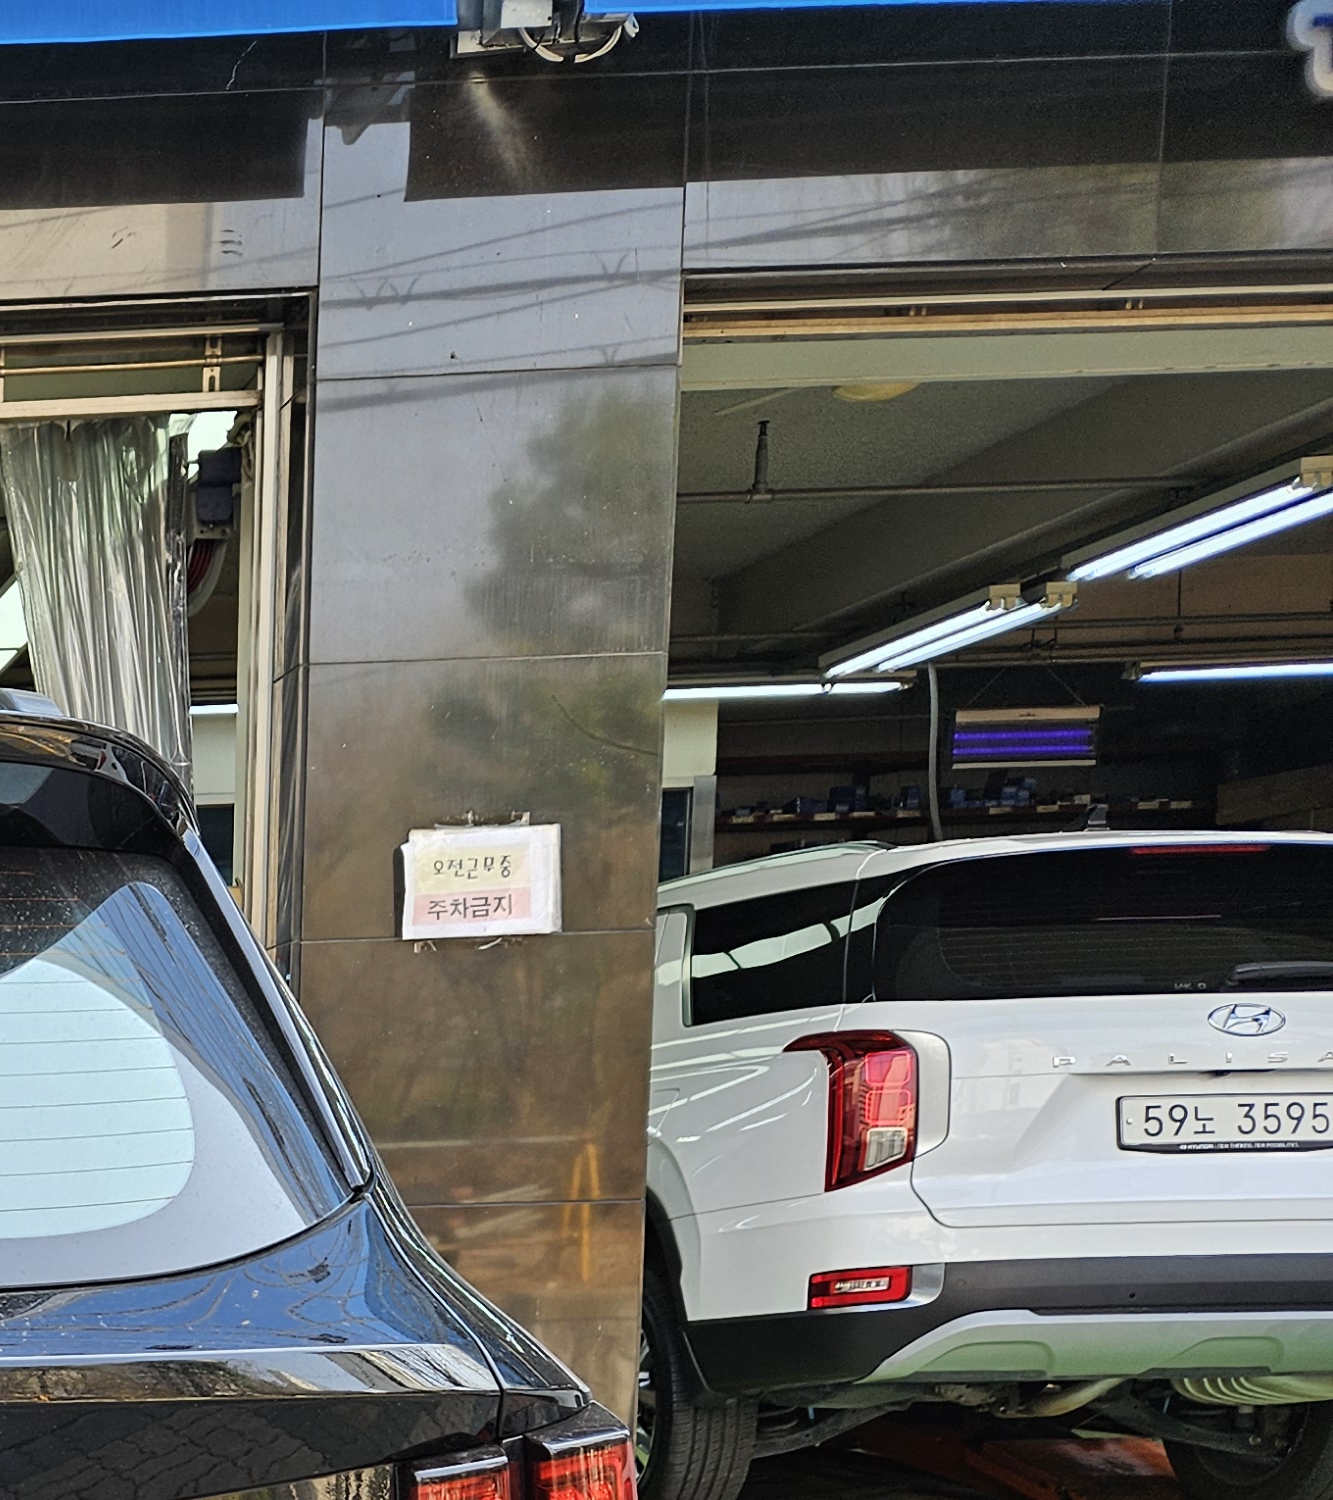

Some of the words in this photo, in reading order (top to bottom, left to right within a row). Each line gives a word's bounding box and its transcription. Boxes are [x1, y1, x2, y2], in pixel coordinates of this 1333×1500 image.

[427, 893, 513, 920] 주차금지
[1144, 1104, 1216, 1137] 59노
[1237, 1102, 1330, 1135] 3595
